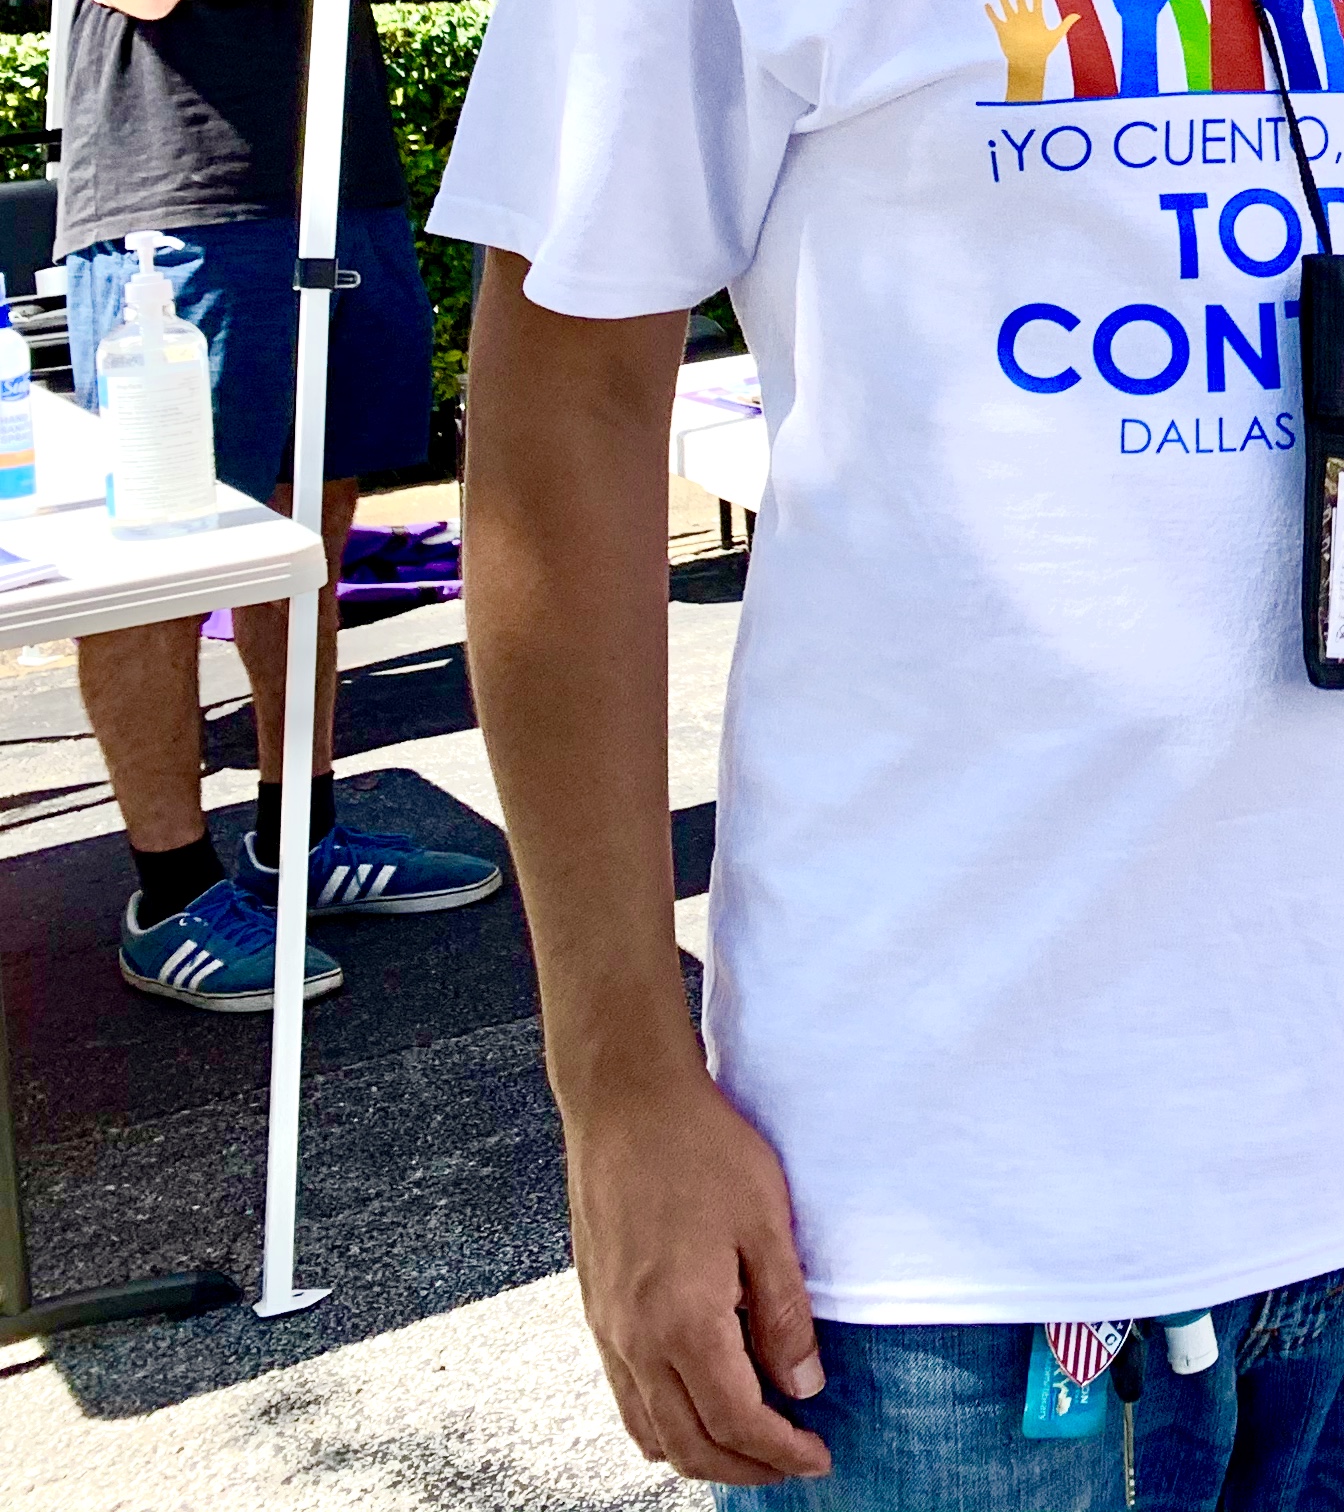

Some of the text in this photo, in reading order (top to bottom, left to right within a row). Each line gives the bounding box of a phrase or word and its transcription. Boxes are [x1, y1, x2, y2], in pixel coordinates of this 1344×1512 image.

[988, 125, 1093, 182] ¡YO
[1113, 115, 1344, 169] CUENTO,
[1120, 411, 1296, 455] DALLAS
